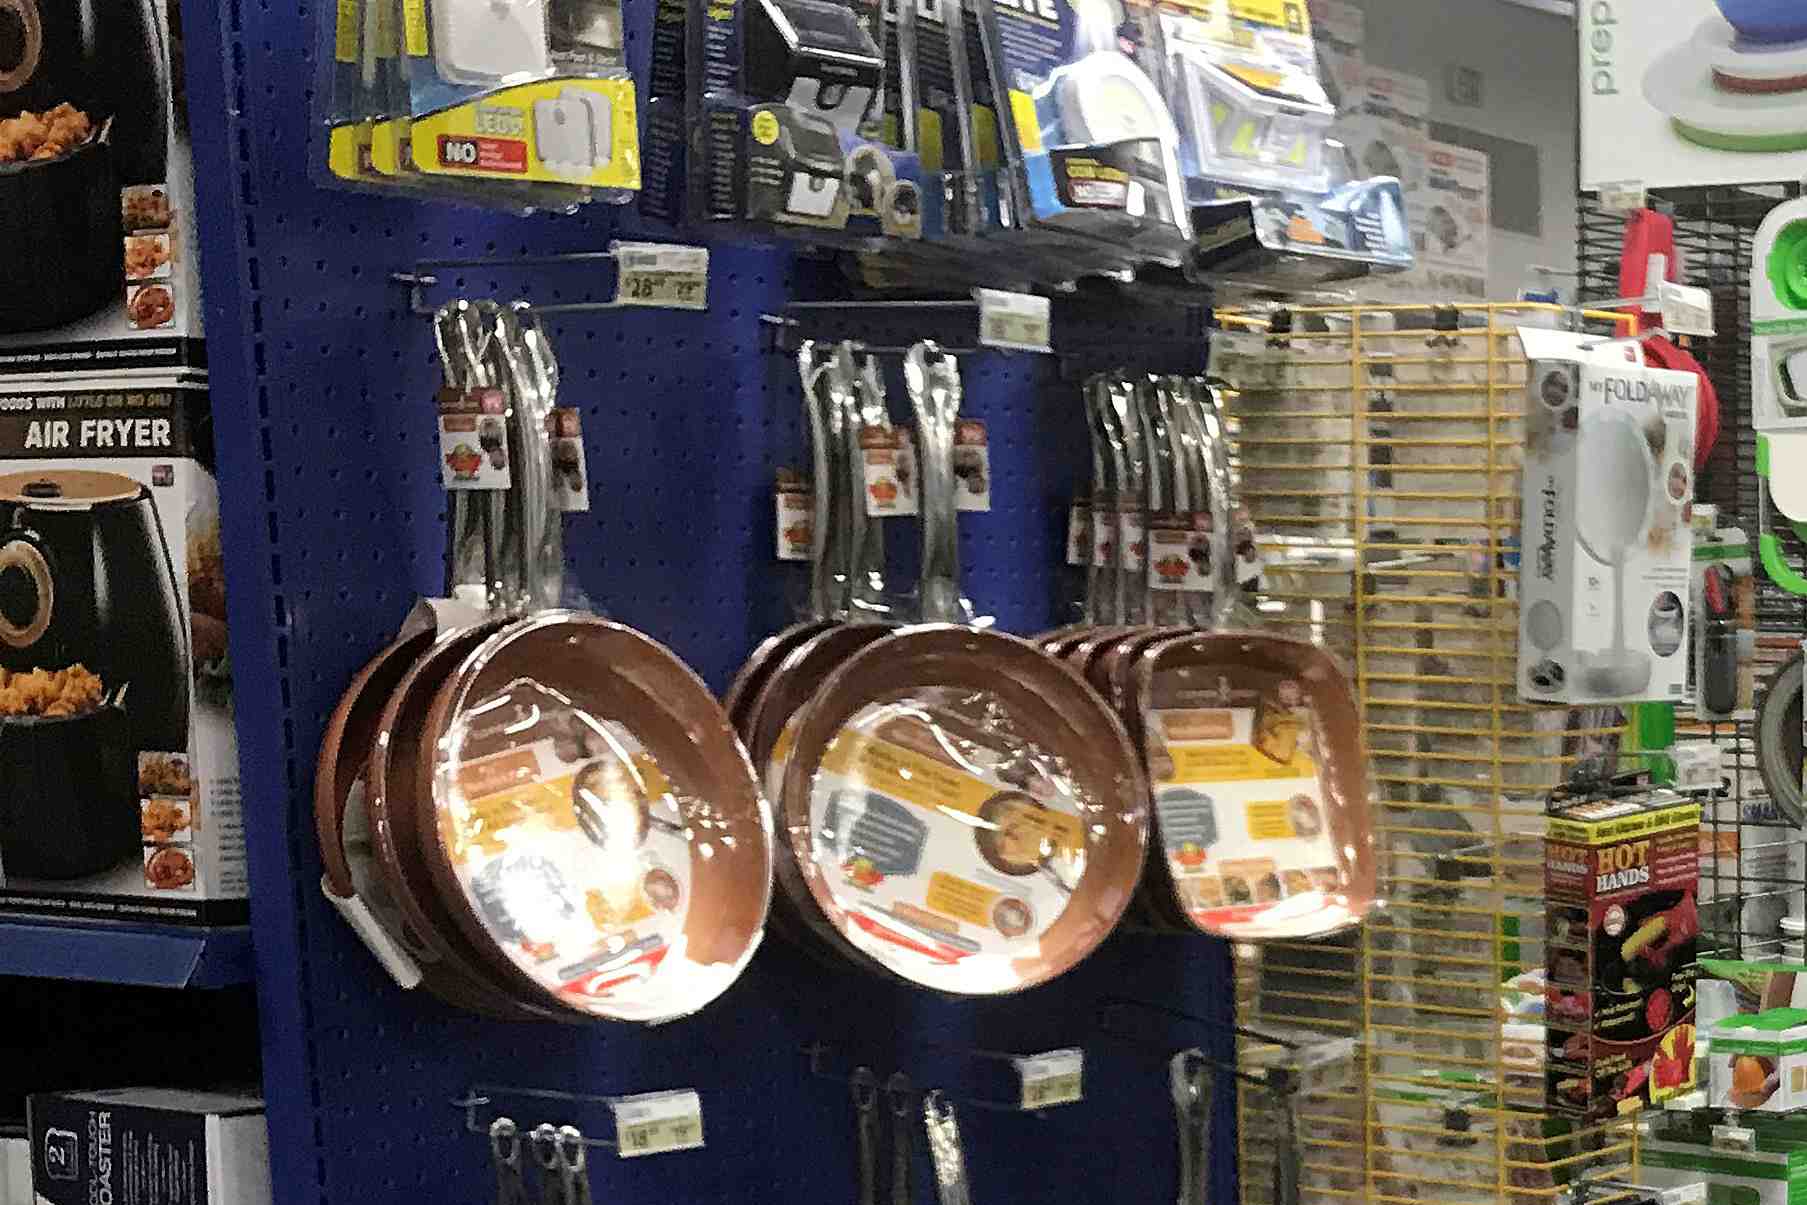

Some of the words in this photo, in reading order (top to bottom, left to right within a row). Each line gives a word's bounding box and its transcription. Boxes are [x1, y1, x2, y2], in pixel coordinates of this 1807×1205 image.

[445, 141, 477, 163] NO
[1605, 378, 1689, 404] FOLDAWAY
[24, 420, 70, 448] AIR
[80, 418, 171, 447] FRYER
[1598, 840, 1650, 874] HOT
[1596, 866, 1650, 893] HANDS
[49, 1144, 65, 1166] 2
